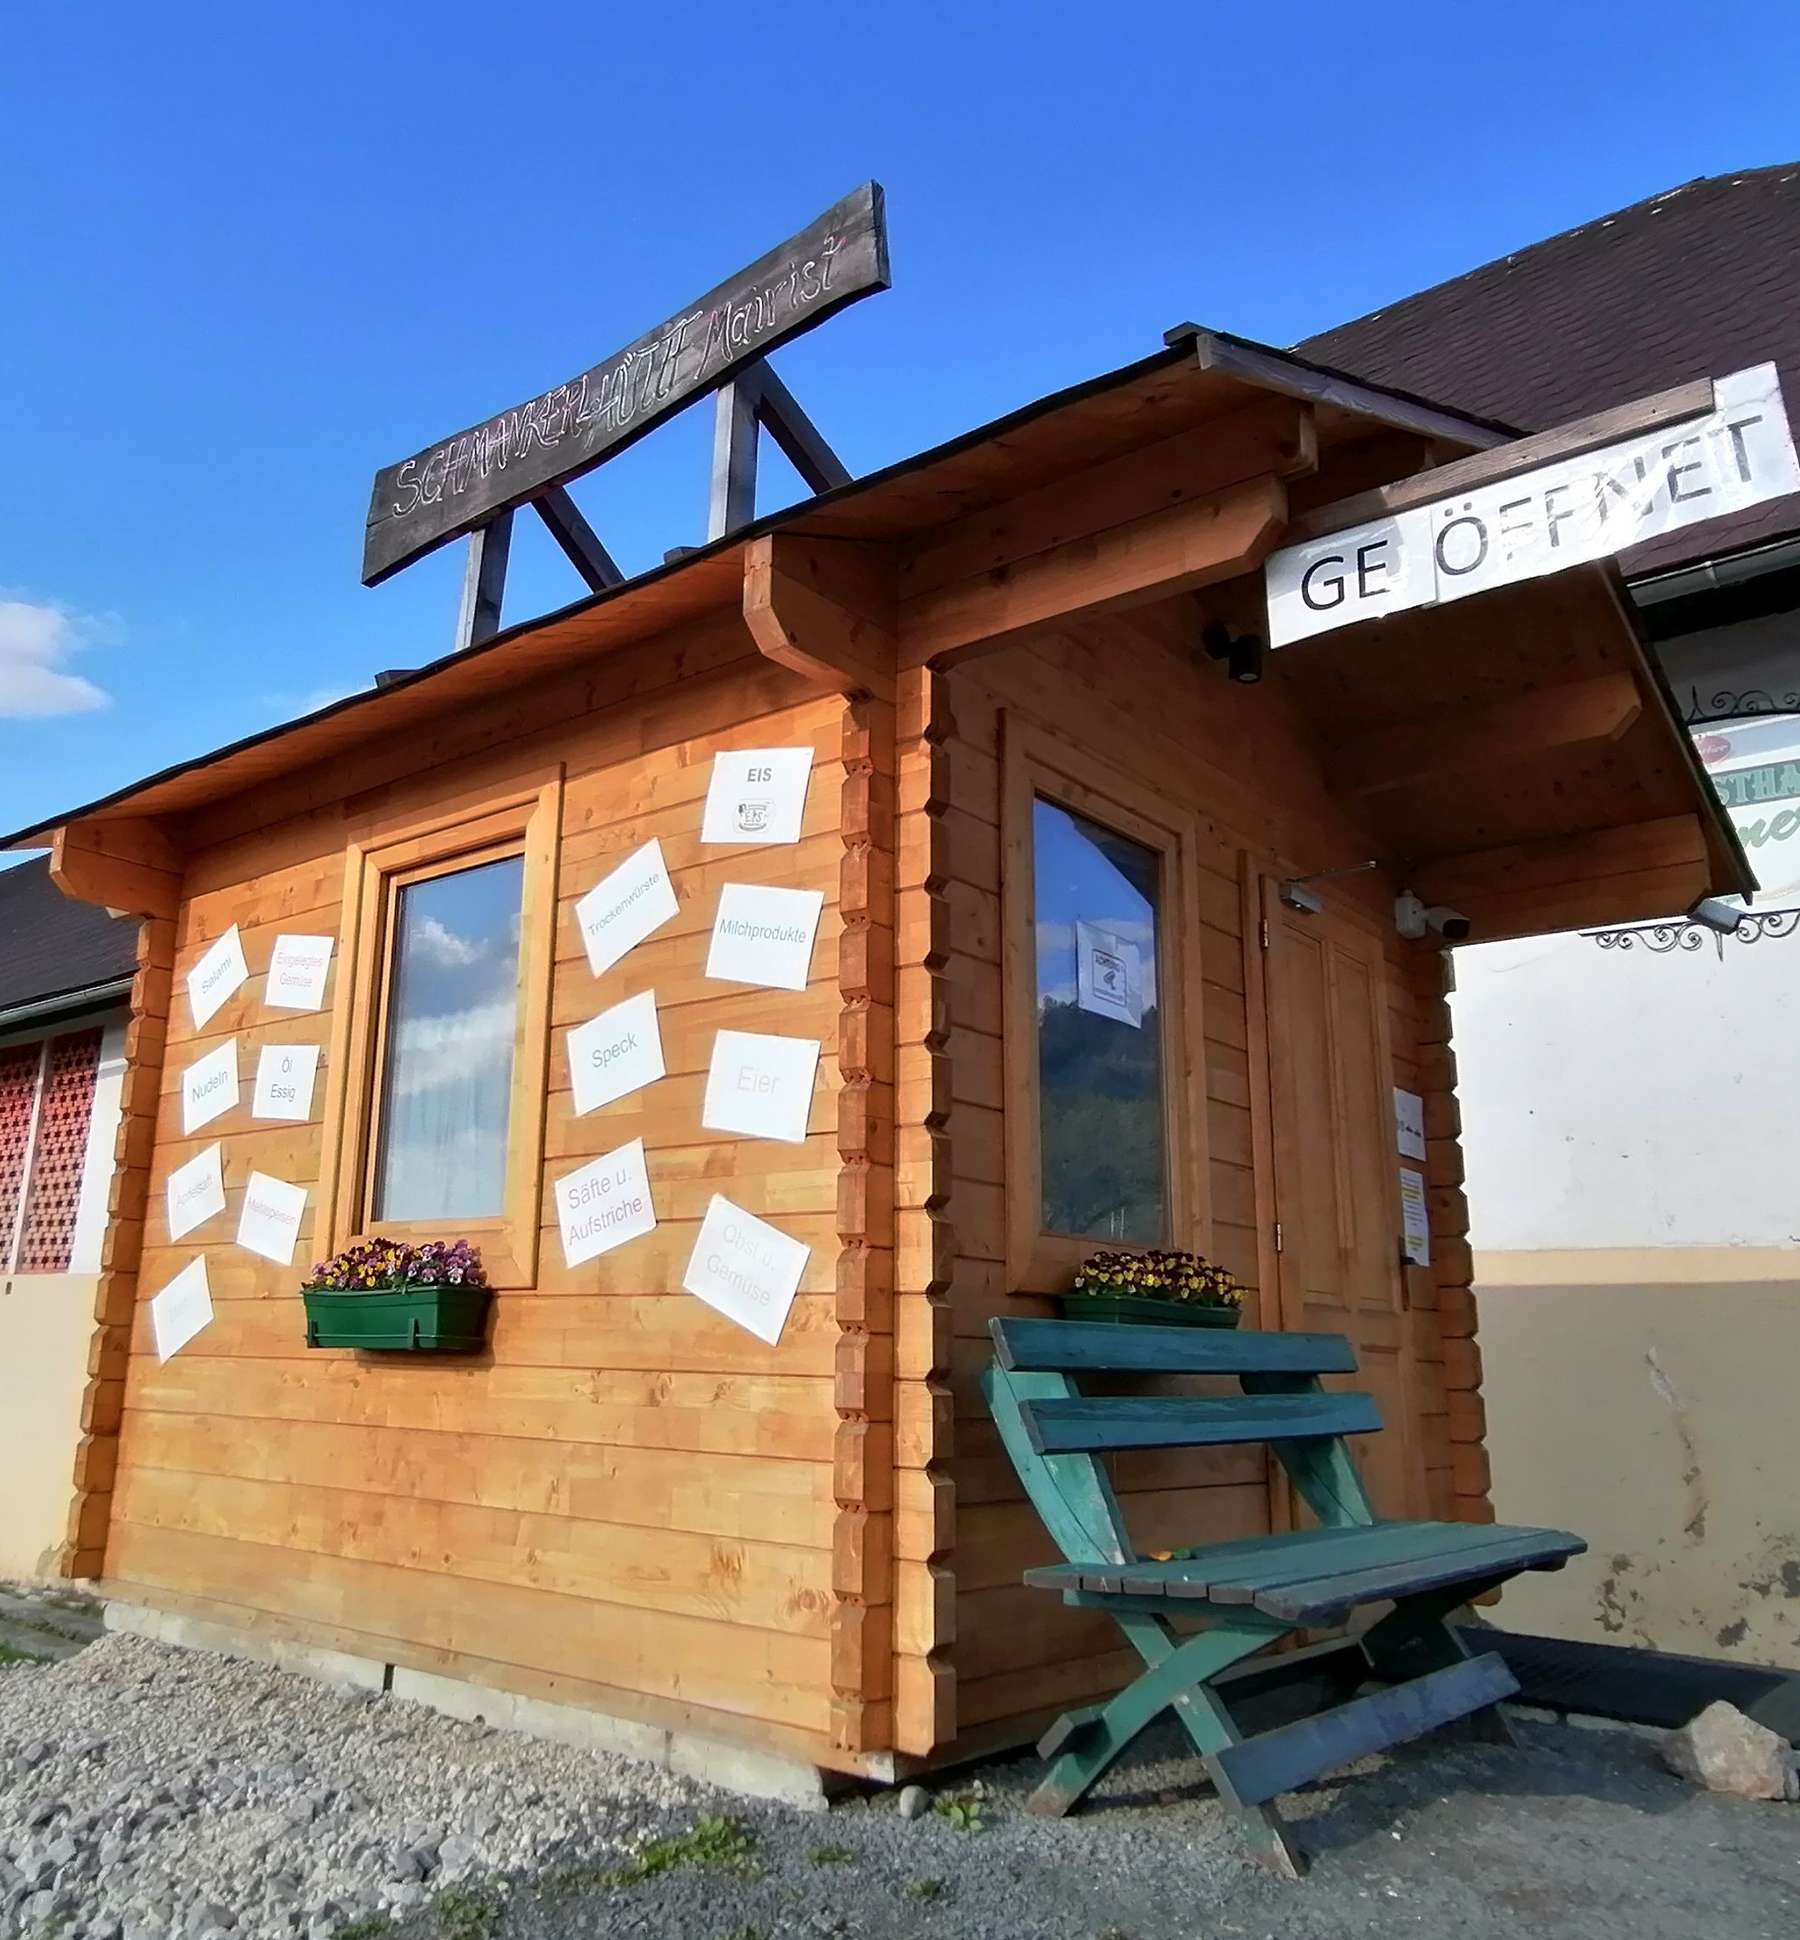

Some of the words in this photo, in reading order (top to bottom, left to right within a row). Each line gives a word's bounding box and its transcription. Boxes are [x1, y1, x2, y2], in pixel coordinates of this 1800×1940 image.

[746, 767, 773, 783] EIS
[587, 872, 661, 936] Trockenwürste
[719, 918, 807, 944] Milchprodukte
[201, 956, 233, 995] Salami
[281, 1056, 294, 1074] Öl
[591, 1031, 639, 1069] Speck
[191, 1070, 228, 1102] Nudeln
[270, 1083, 297, 1102] Essig
[736, 1064, 780, 1095] Eier
[568, 1174, 611, 1210] Säfte
[616, 1167, 632, 1187] u.
[568, 1196, 643, 1246] Aufstriche
[723, 1223, 757, 1257] Obst
[706, 1253, 771, 1307] Gemüse
